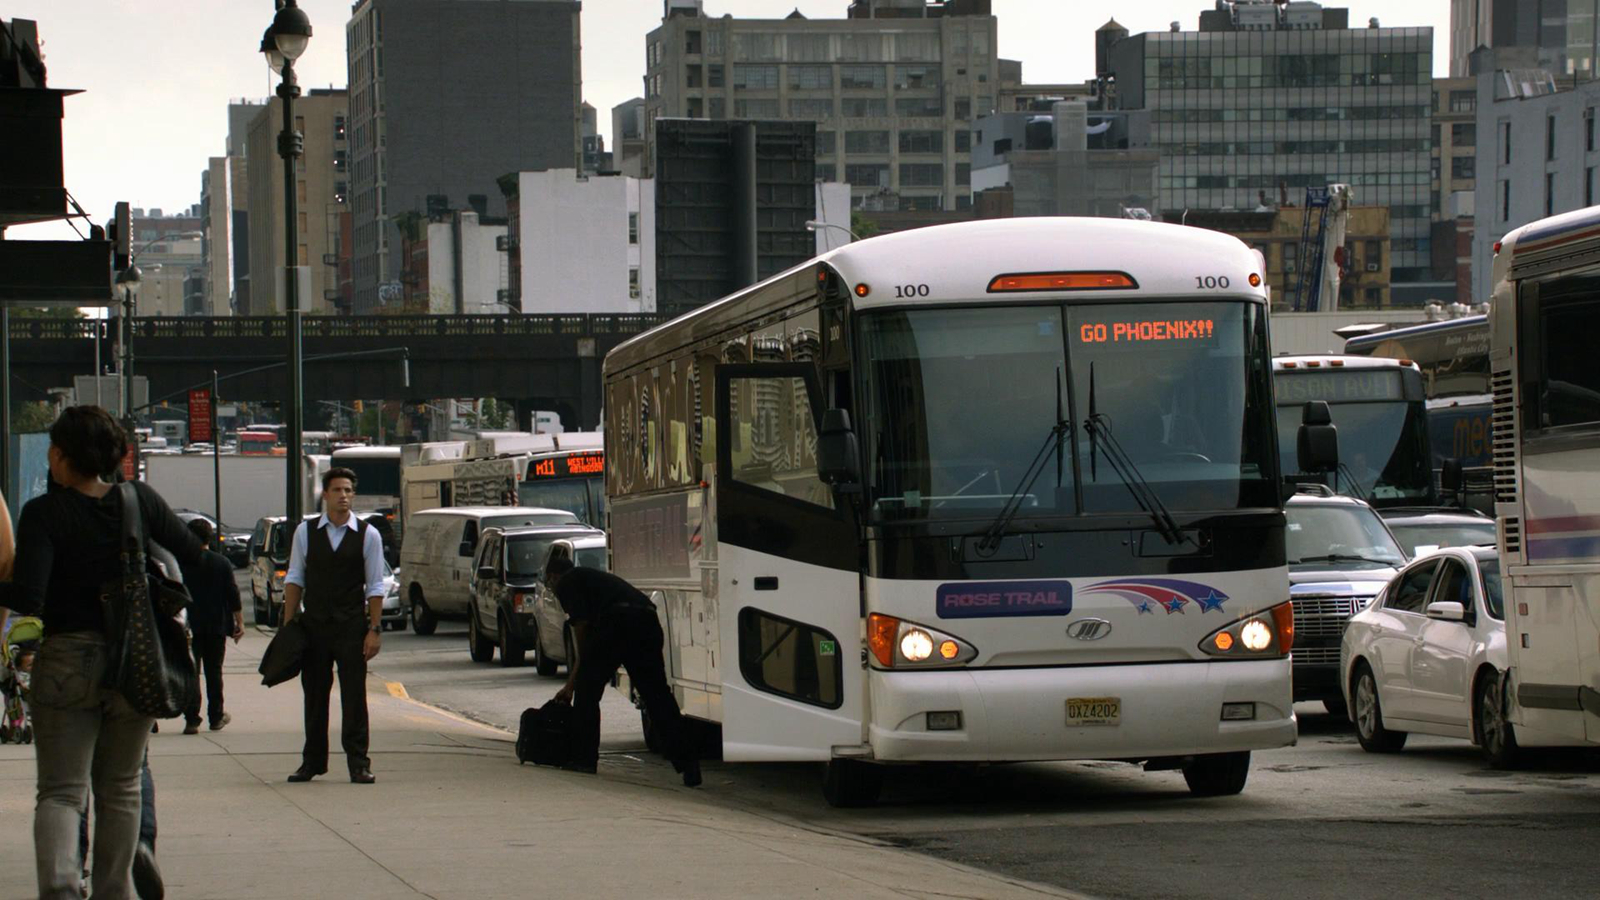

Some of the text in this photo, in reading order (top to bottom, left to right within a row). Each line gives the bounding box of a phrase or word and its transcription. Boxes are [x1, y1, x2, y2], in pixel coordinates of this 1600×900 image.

[1195, 275, 1230, 290] 100
[895, 283, 930, 299] 100
[1080, 319, 1214, 343] GO PHOENIX!!
[1275, 377, 1336, 401] ISON
[536, 459, 555, 475] M11
[944, 591, 1064, 607] ROSE TRAIL
